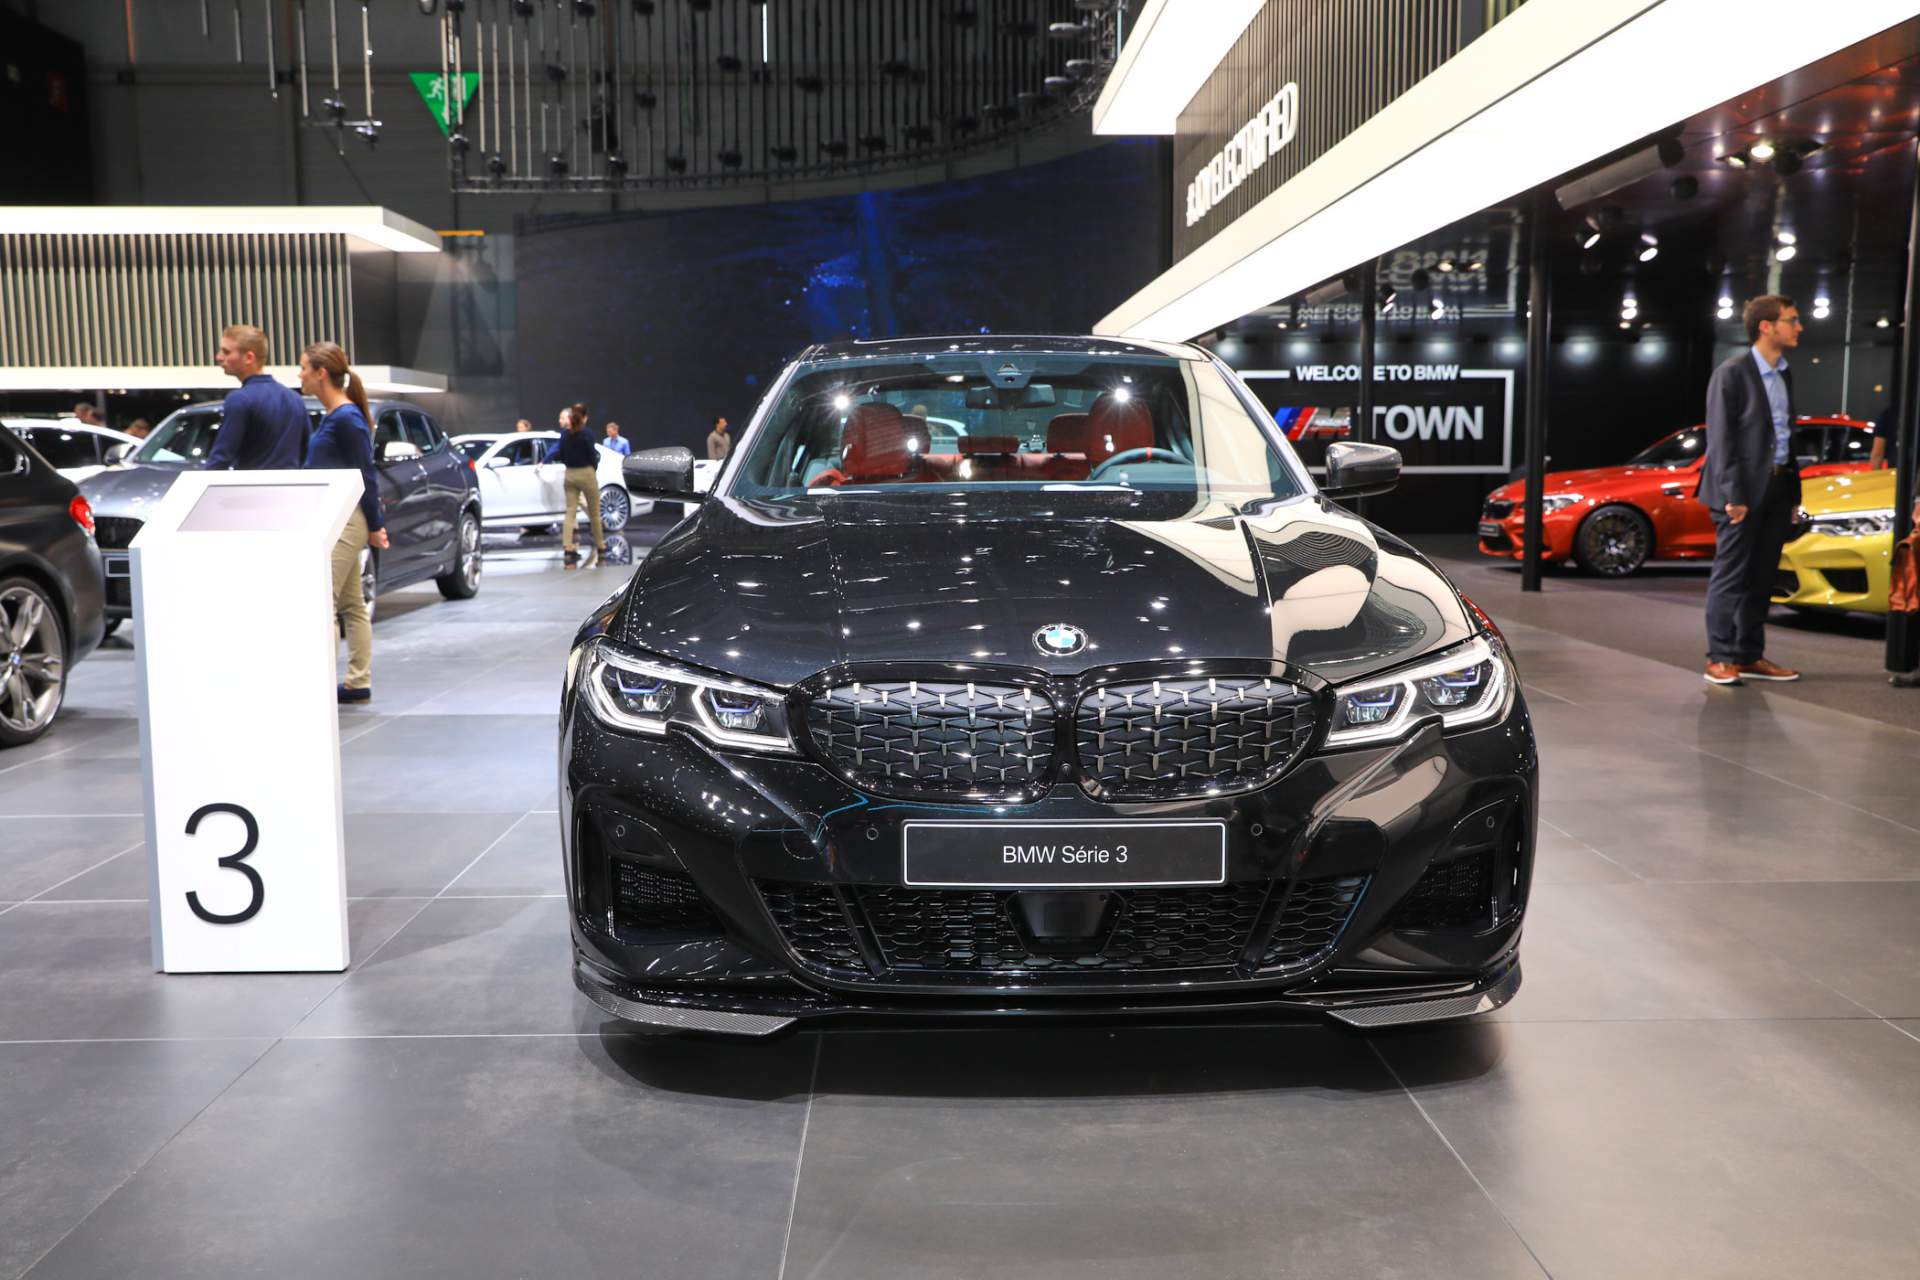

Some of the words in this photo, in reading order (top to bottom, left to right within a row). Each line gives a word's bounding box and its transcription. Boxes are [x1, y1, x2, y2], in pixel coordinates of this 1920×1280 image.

[1296, 365, 1386, 381] WELCOE
[1386, 365, 1412, 381] TO
[1413, 365, 1459, 381] BMW
[1003, 846, 1056, 863] BMW
[1062, 845, 1110, 863] Série
[1115, 845, 1128, 863] 3
[184, 802, 265, 925] 3
